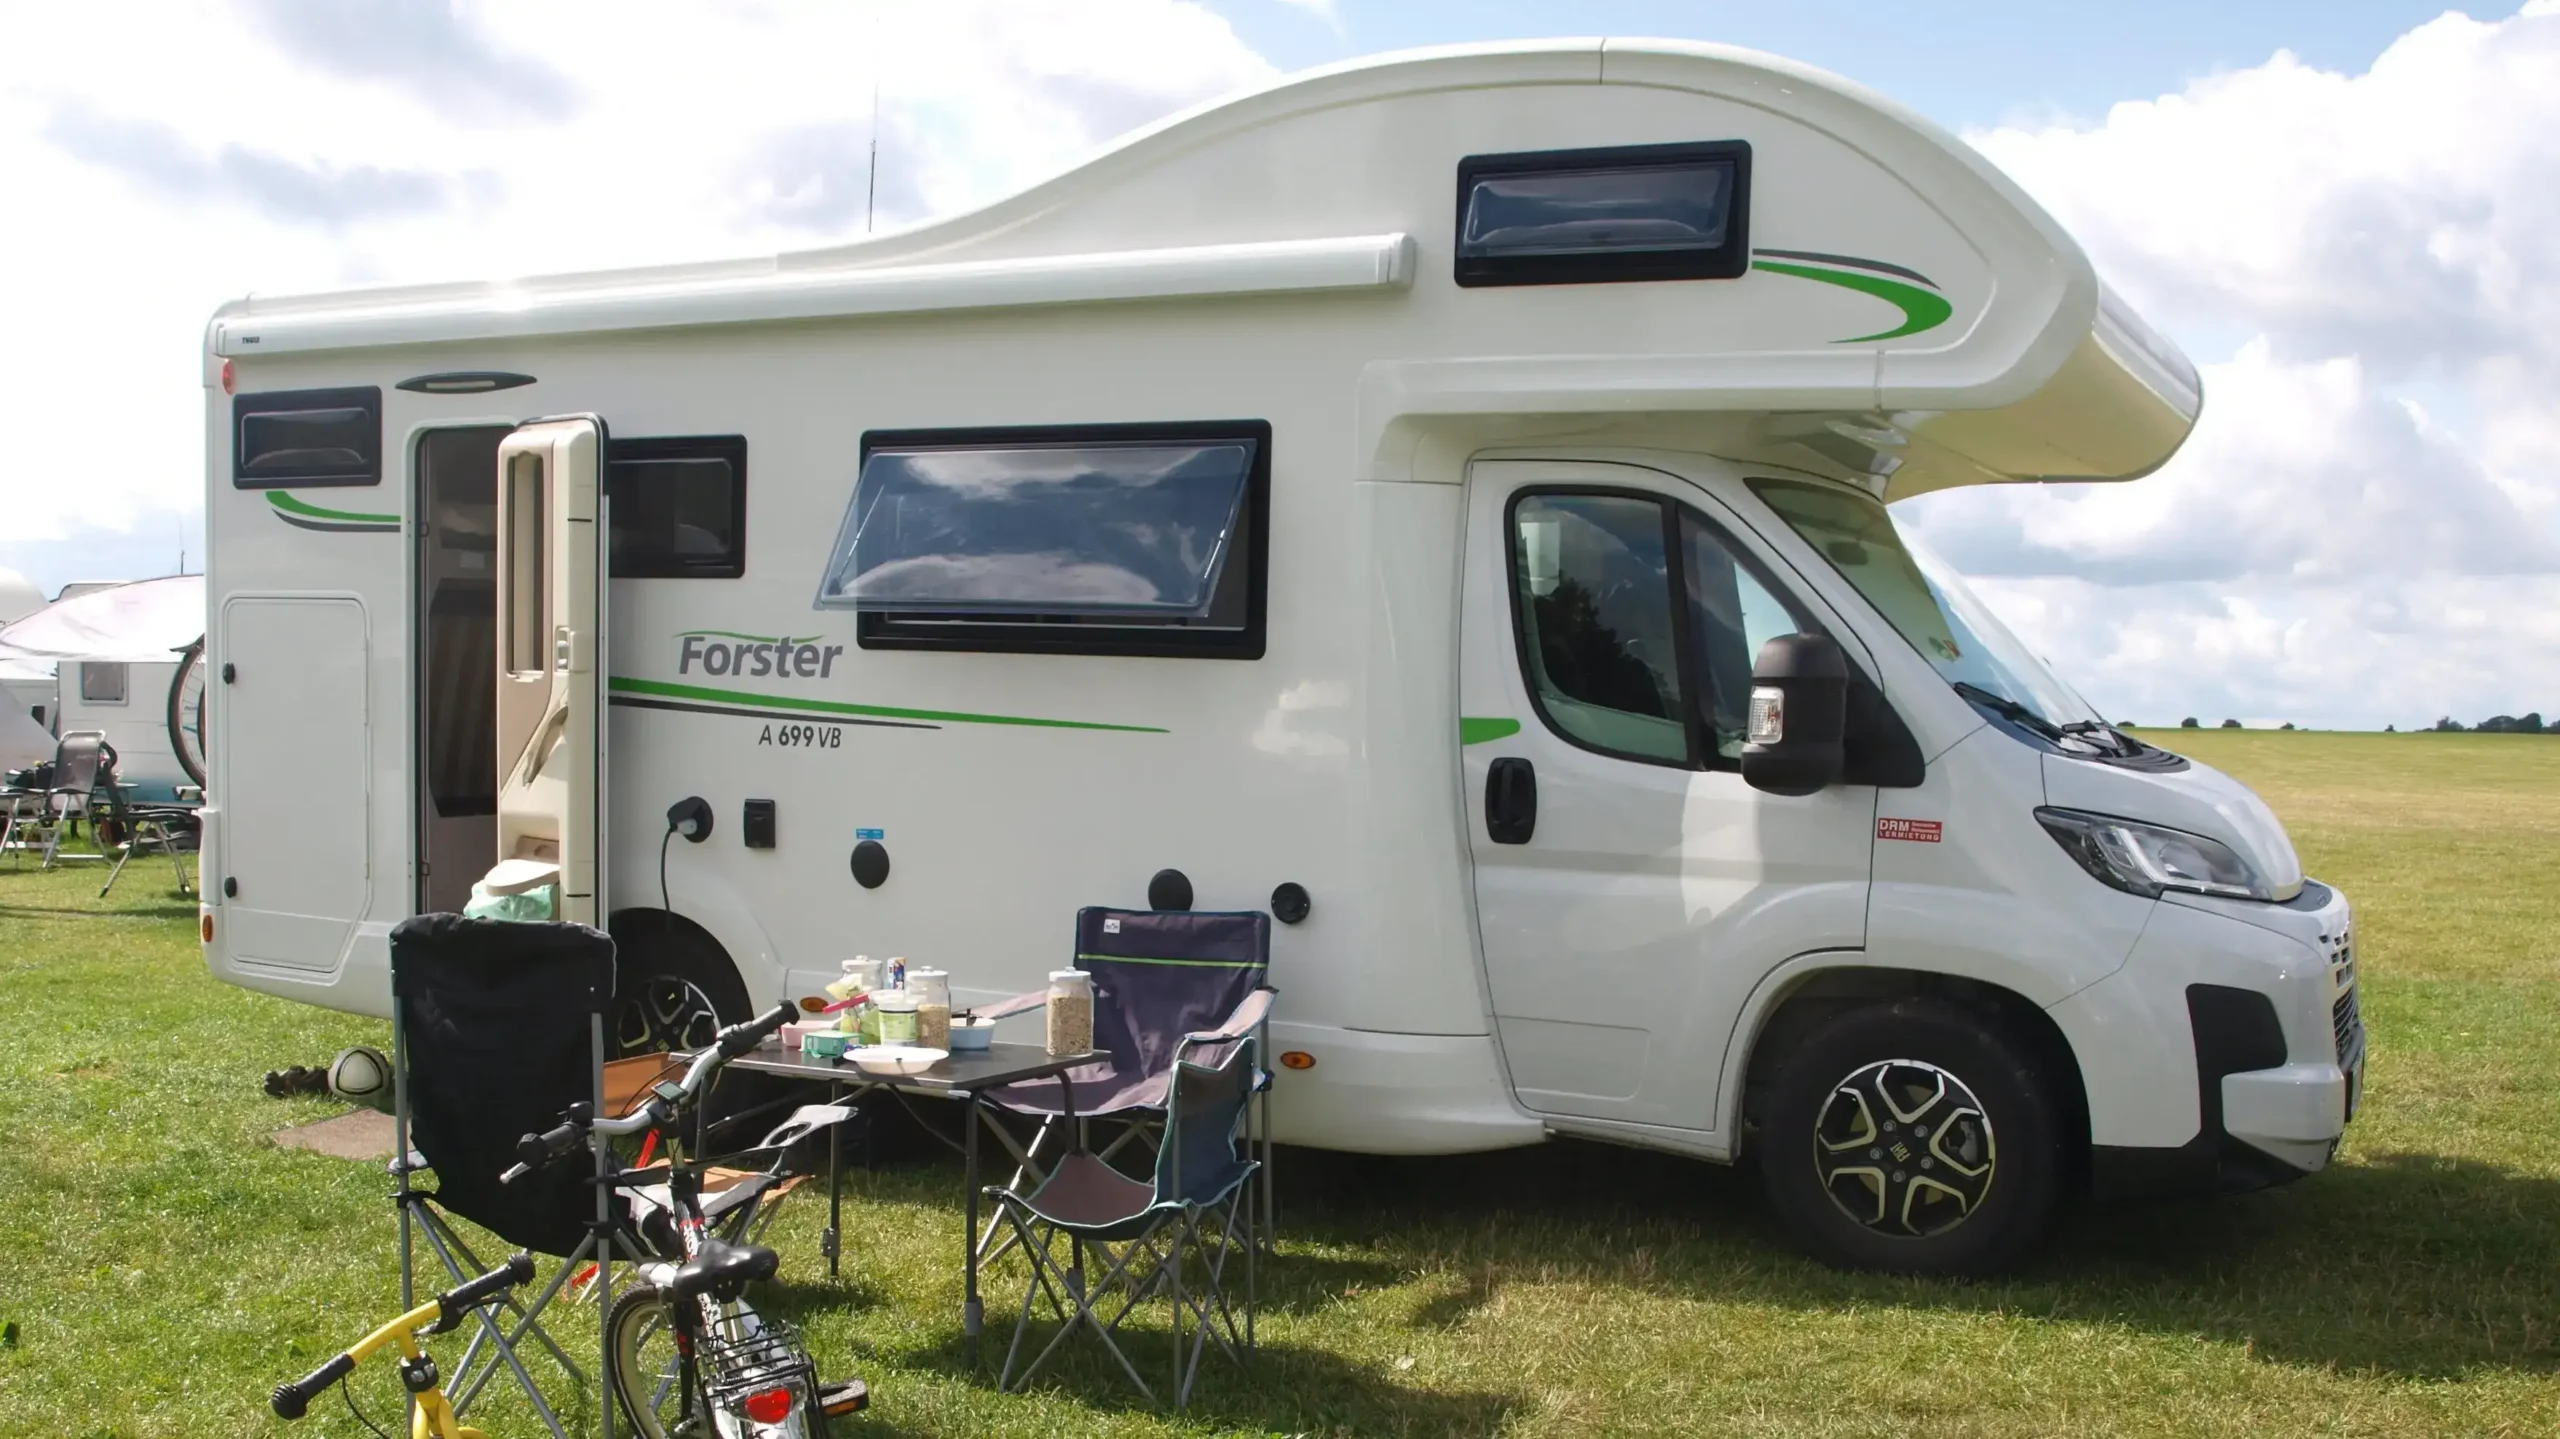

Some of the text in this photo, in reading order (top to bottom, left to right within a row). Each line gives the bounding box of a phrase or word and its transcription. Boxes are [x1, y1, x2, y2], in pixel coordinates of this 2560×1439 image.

[679, 636, 843, 678] Forster
[758, 725, 842, 748] A 699 VB
[1879, 820, 1910, 832] DRM
